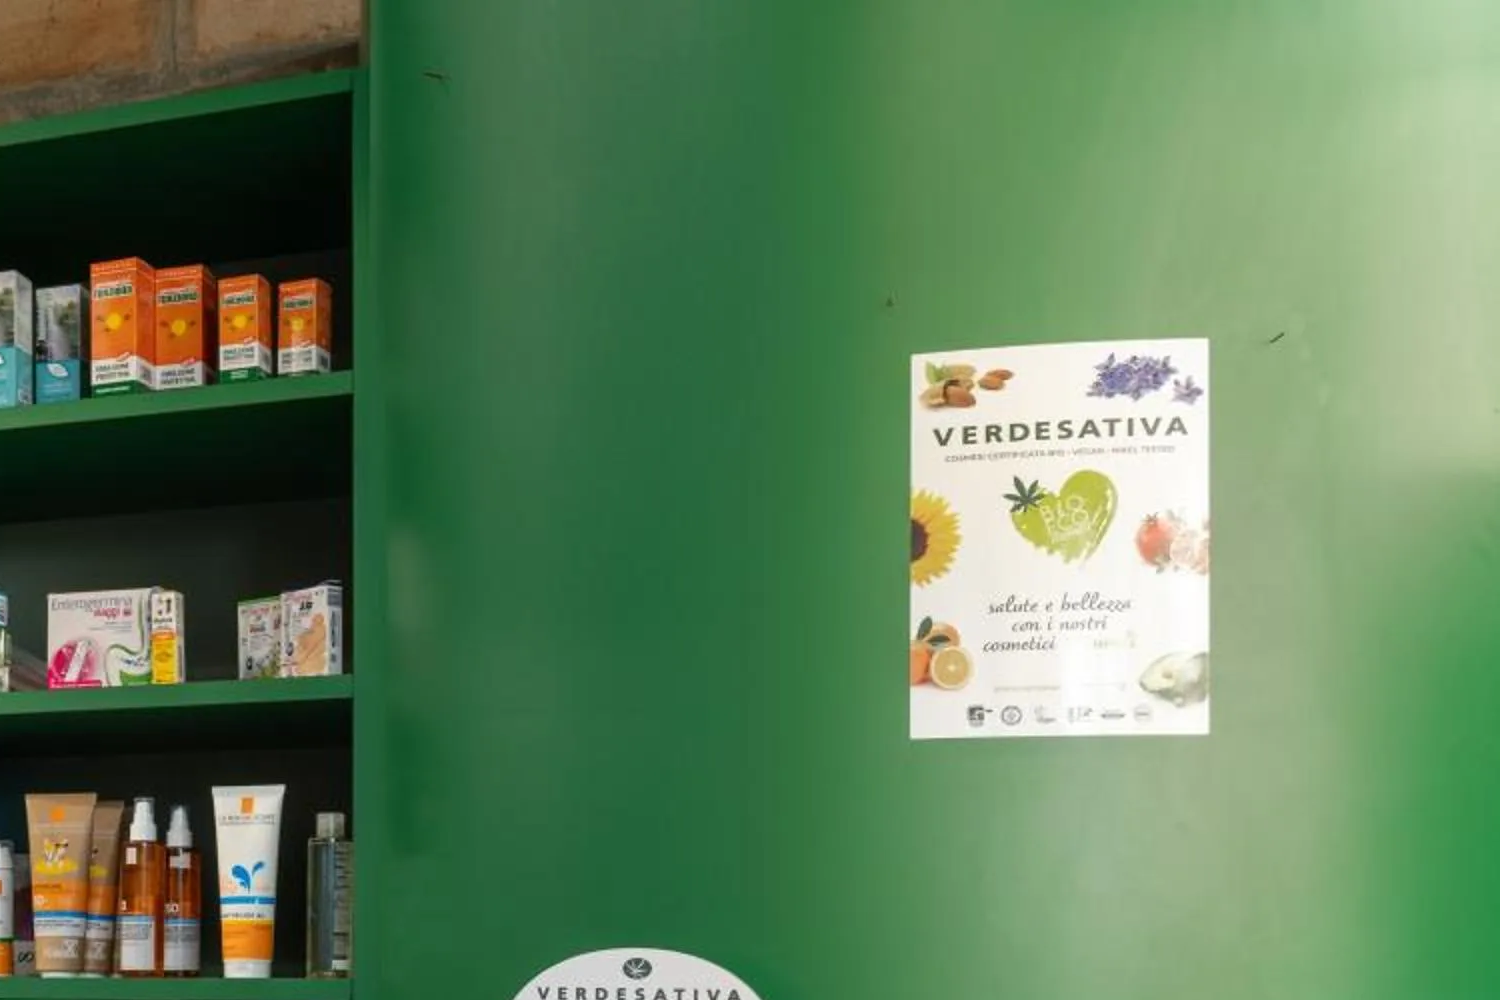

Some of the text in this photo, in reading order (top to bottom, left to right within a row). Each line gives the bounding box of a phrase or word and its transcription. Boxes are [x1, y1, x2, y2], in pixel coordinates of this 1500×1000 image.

[933, 416, 1188, 446] VERDESATIVA
[989, 592, 1130, 614] salute e bellezza
[1012, 616, 1107, 632] con i nostri
[983, 636, 1056, 652] cosmetici
